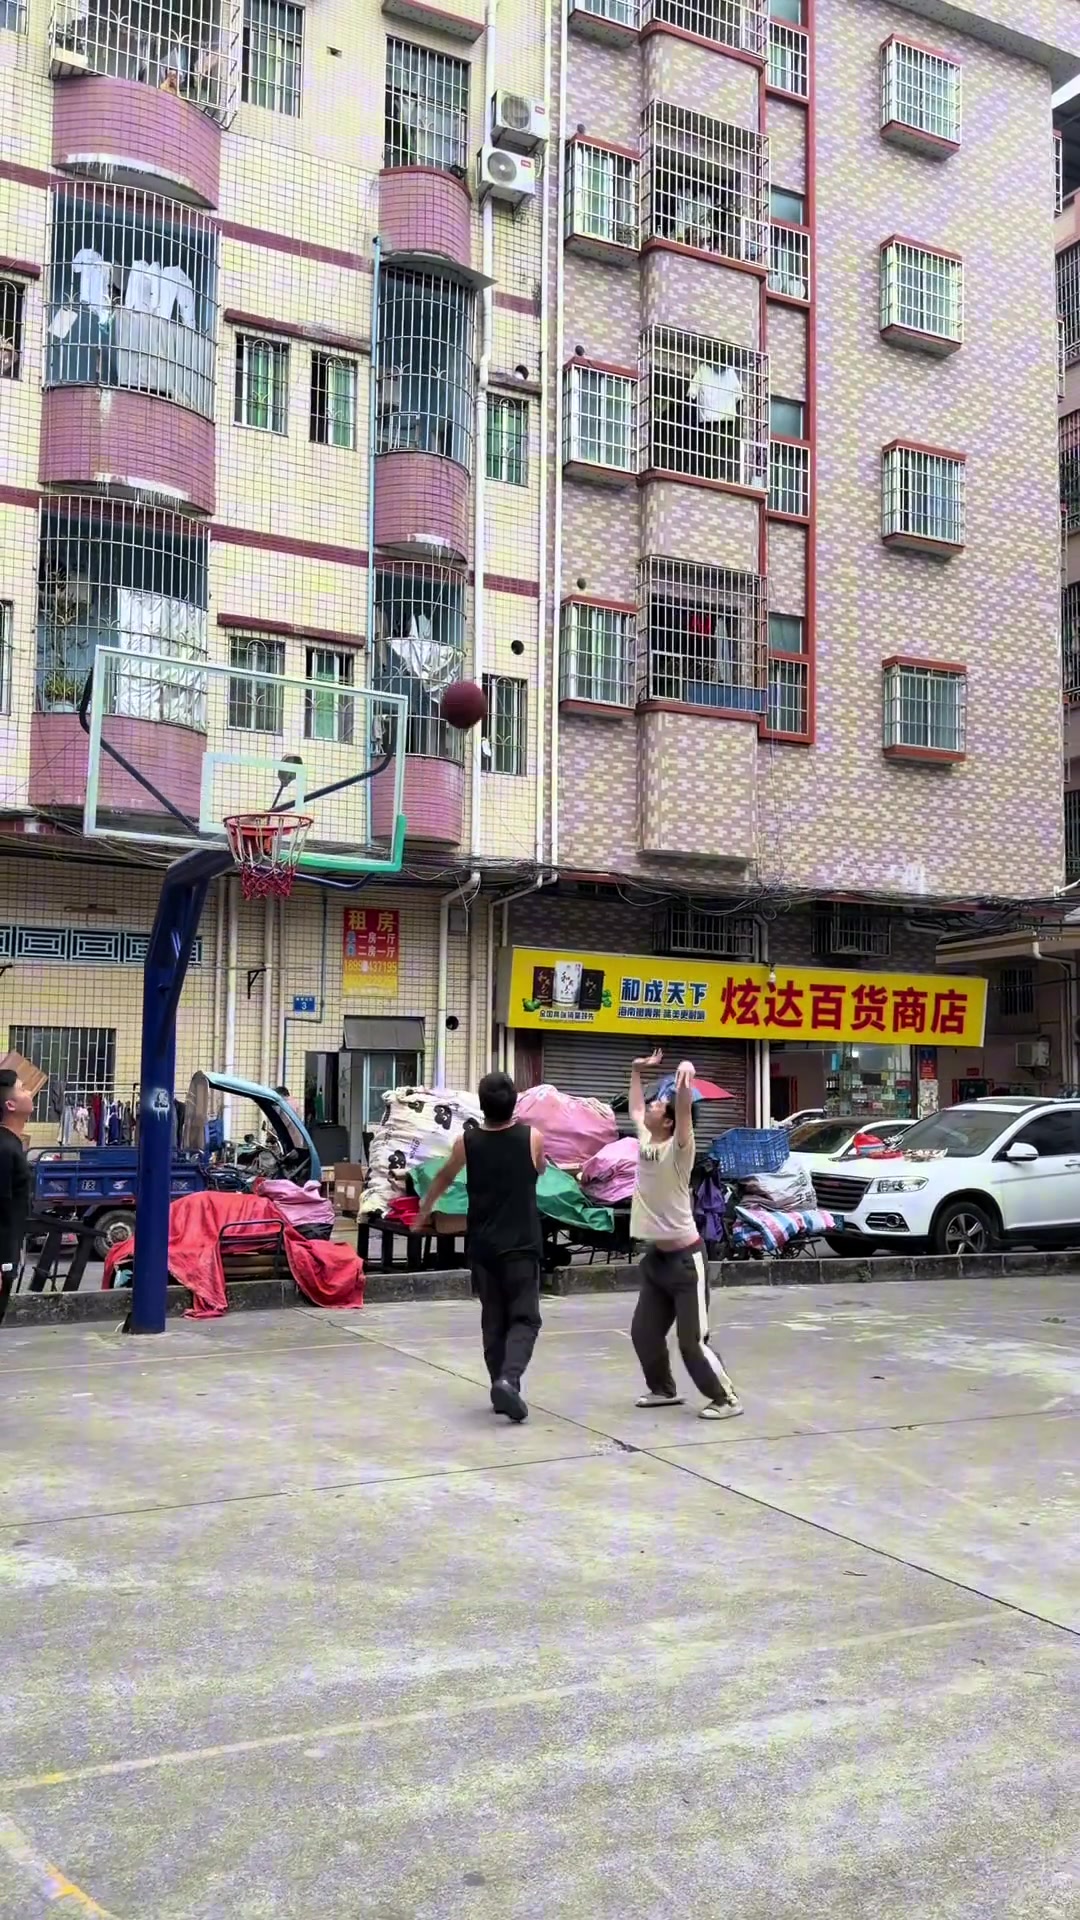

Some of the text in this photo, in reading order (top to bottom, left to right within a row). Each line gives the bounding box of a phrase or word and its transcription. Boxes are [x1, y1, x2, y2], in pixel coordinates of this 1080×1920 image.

[347, 910, 397, 932] 租房
[358, 931, 396, 945] 一房一厅
[358, 945, 396, 958] 二房一厅
[345, 959, 397, 974] 1899437195
[620, 977, 708, 1007] 和成天下
[301, 1001, 307, 1010] 3
[720, 977, 968, 1034] 炫达百货商店
